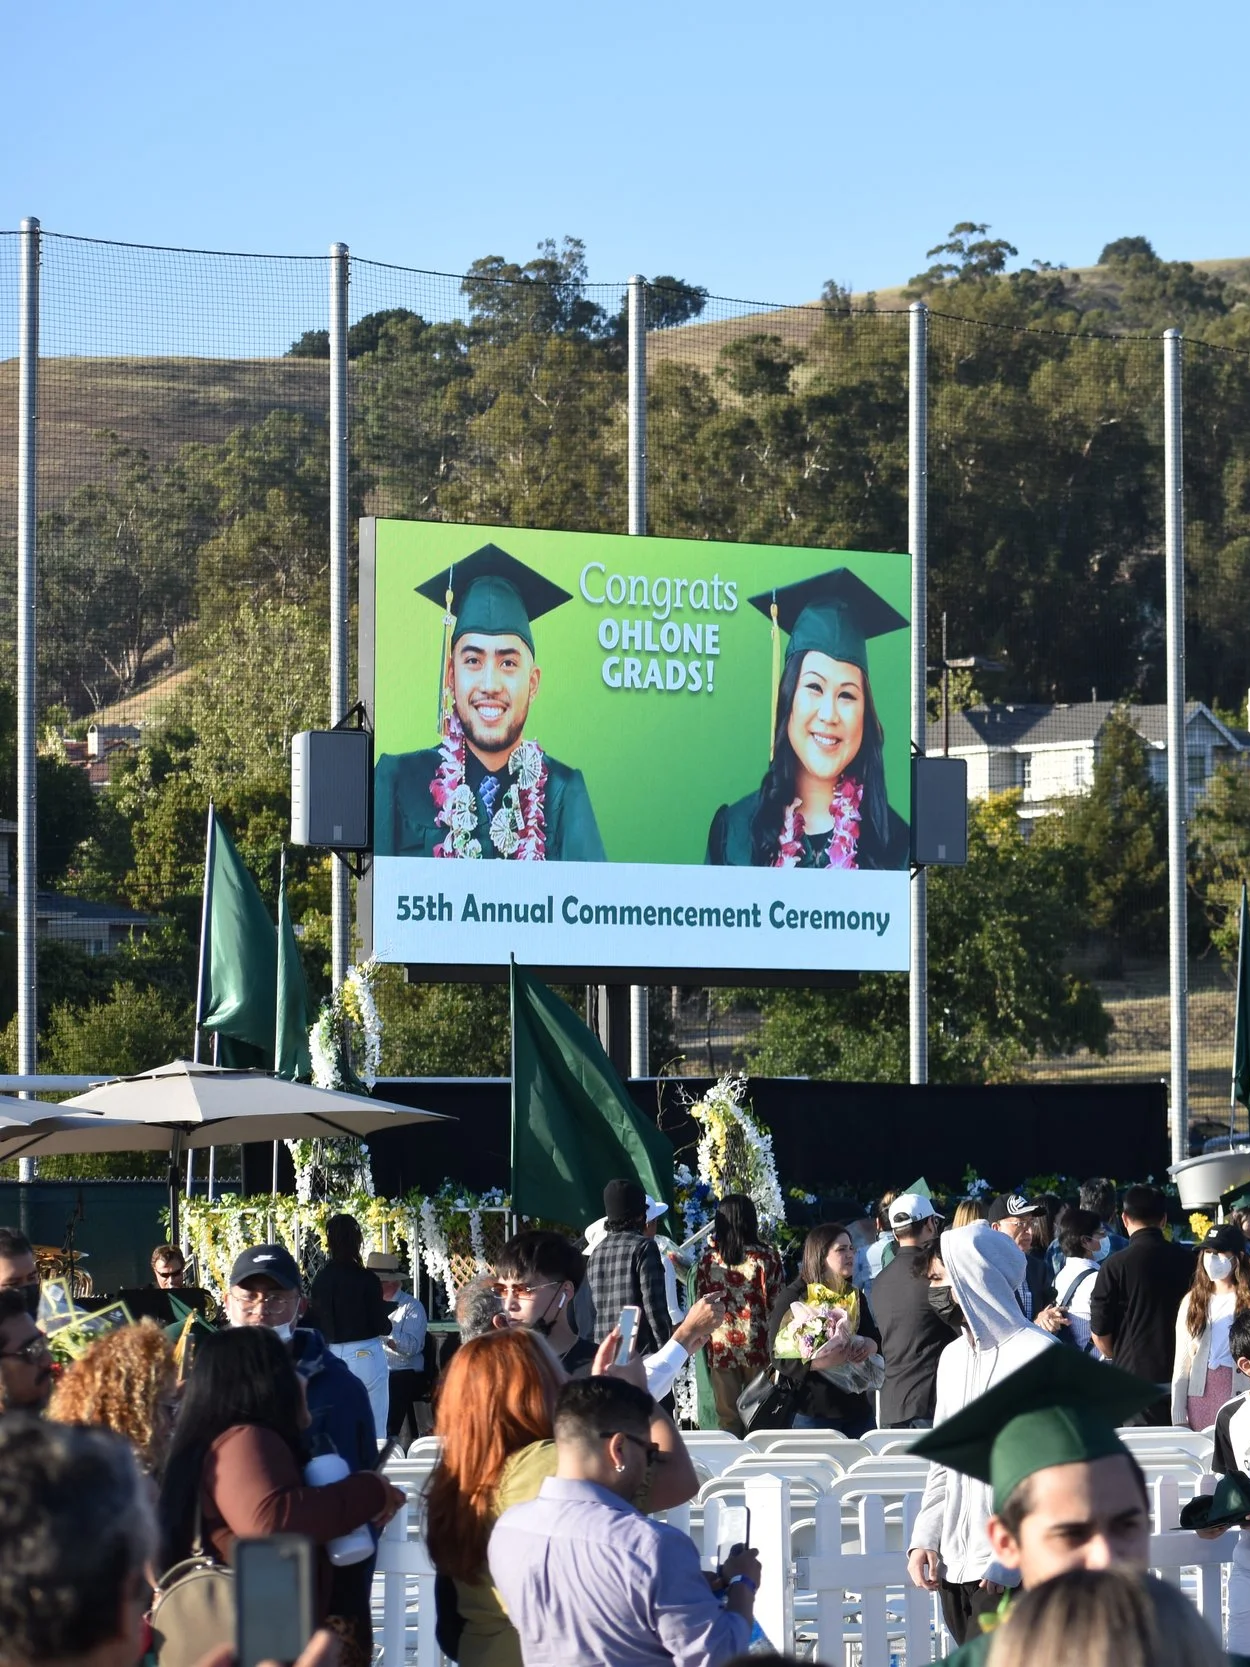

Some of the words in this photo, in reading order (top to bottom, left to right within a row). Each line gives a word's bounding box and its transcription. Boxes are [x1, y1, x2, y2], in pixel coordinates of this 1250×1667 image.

[579, 561, 739, 620] Congrats
[598, 618, 720, 655] OHLONE
[602, 656, 714, 692] GRADS!
[396, 892, 453, 921] 55th
[460, 893, 554, 923] Annual
[561, 895, 762, 928] Commencement
[769, 900, 891, 937] Ceremony
